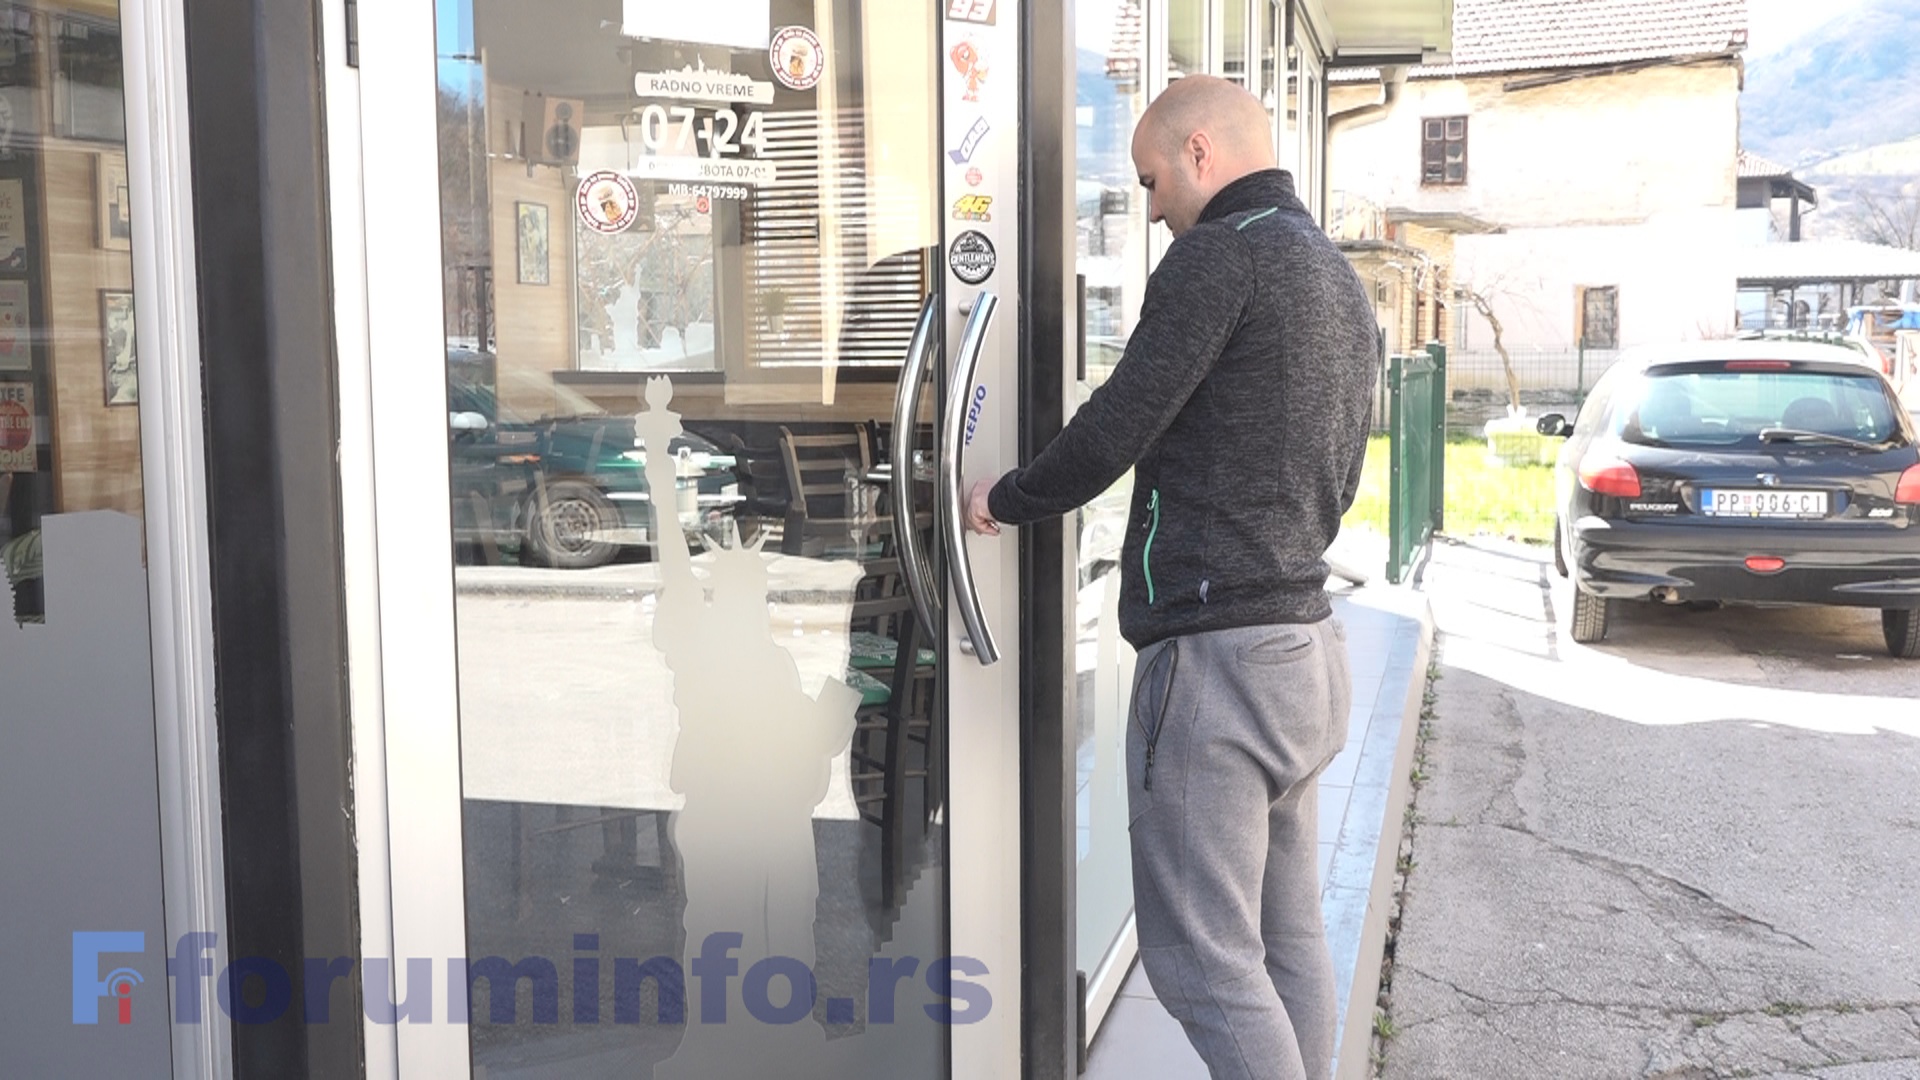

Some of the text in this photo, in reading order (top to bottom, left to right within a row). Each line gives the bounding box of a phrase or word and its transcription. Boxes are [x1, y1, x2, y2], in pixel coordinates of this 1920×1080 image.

[650, 79, 755, 97] RADNO VREME
[641, 104, 767, 158] 07-24
[692, 164, 734, 177] BOTA
[953, 194, 992, 214] 46
[1629, 503, 1679, 513] PEUGEOT
[1717, 493, 1740, 512] PP
